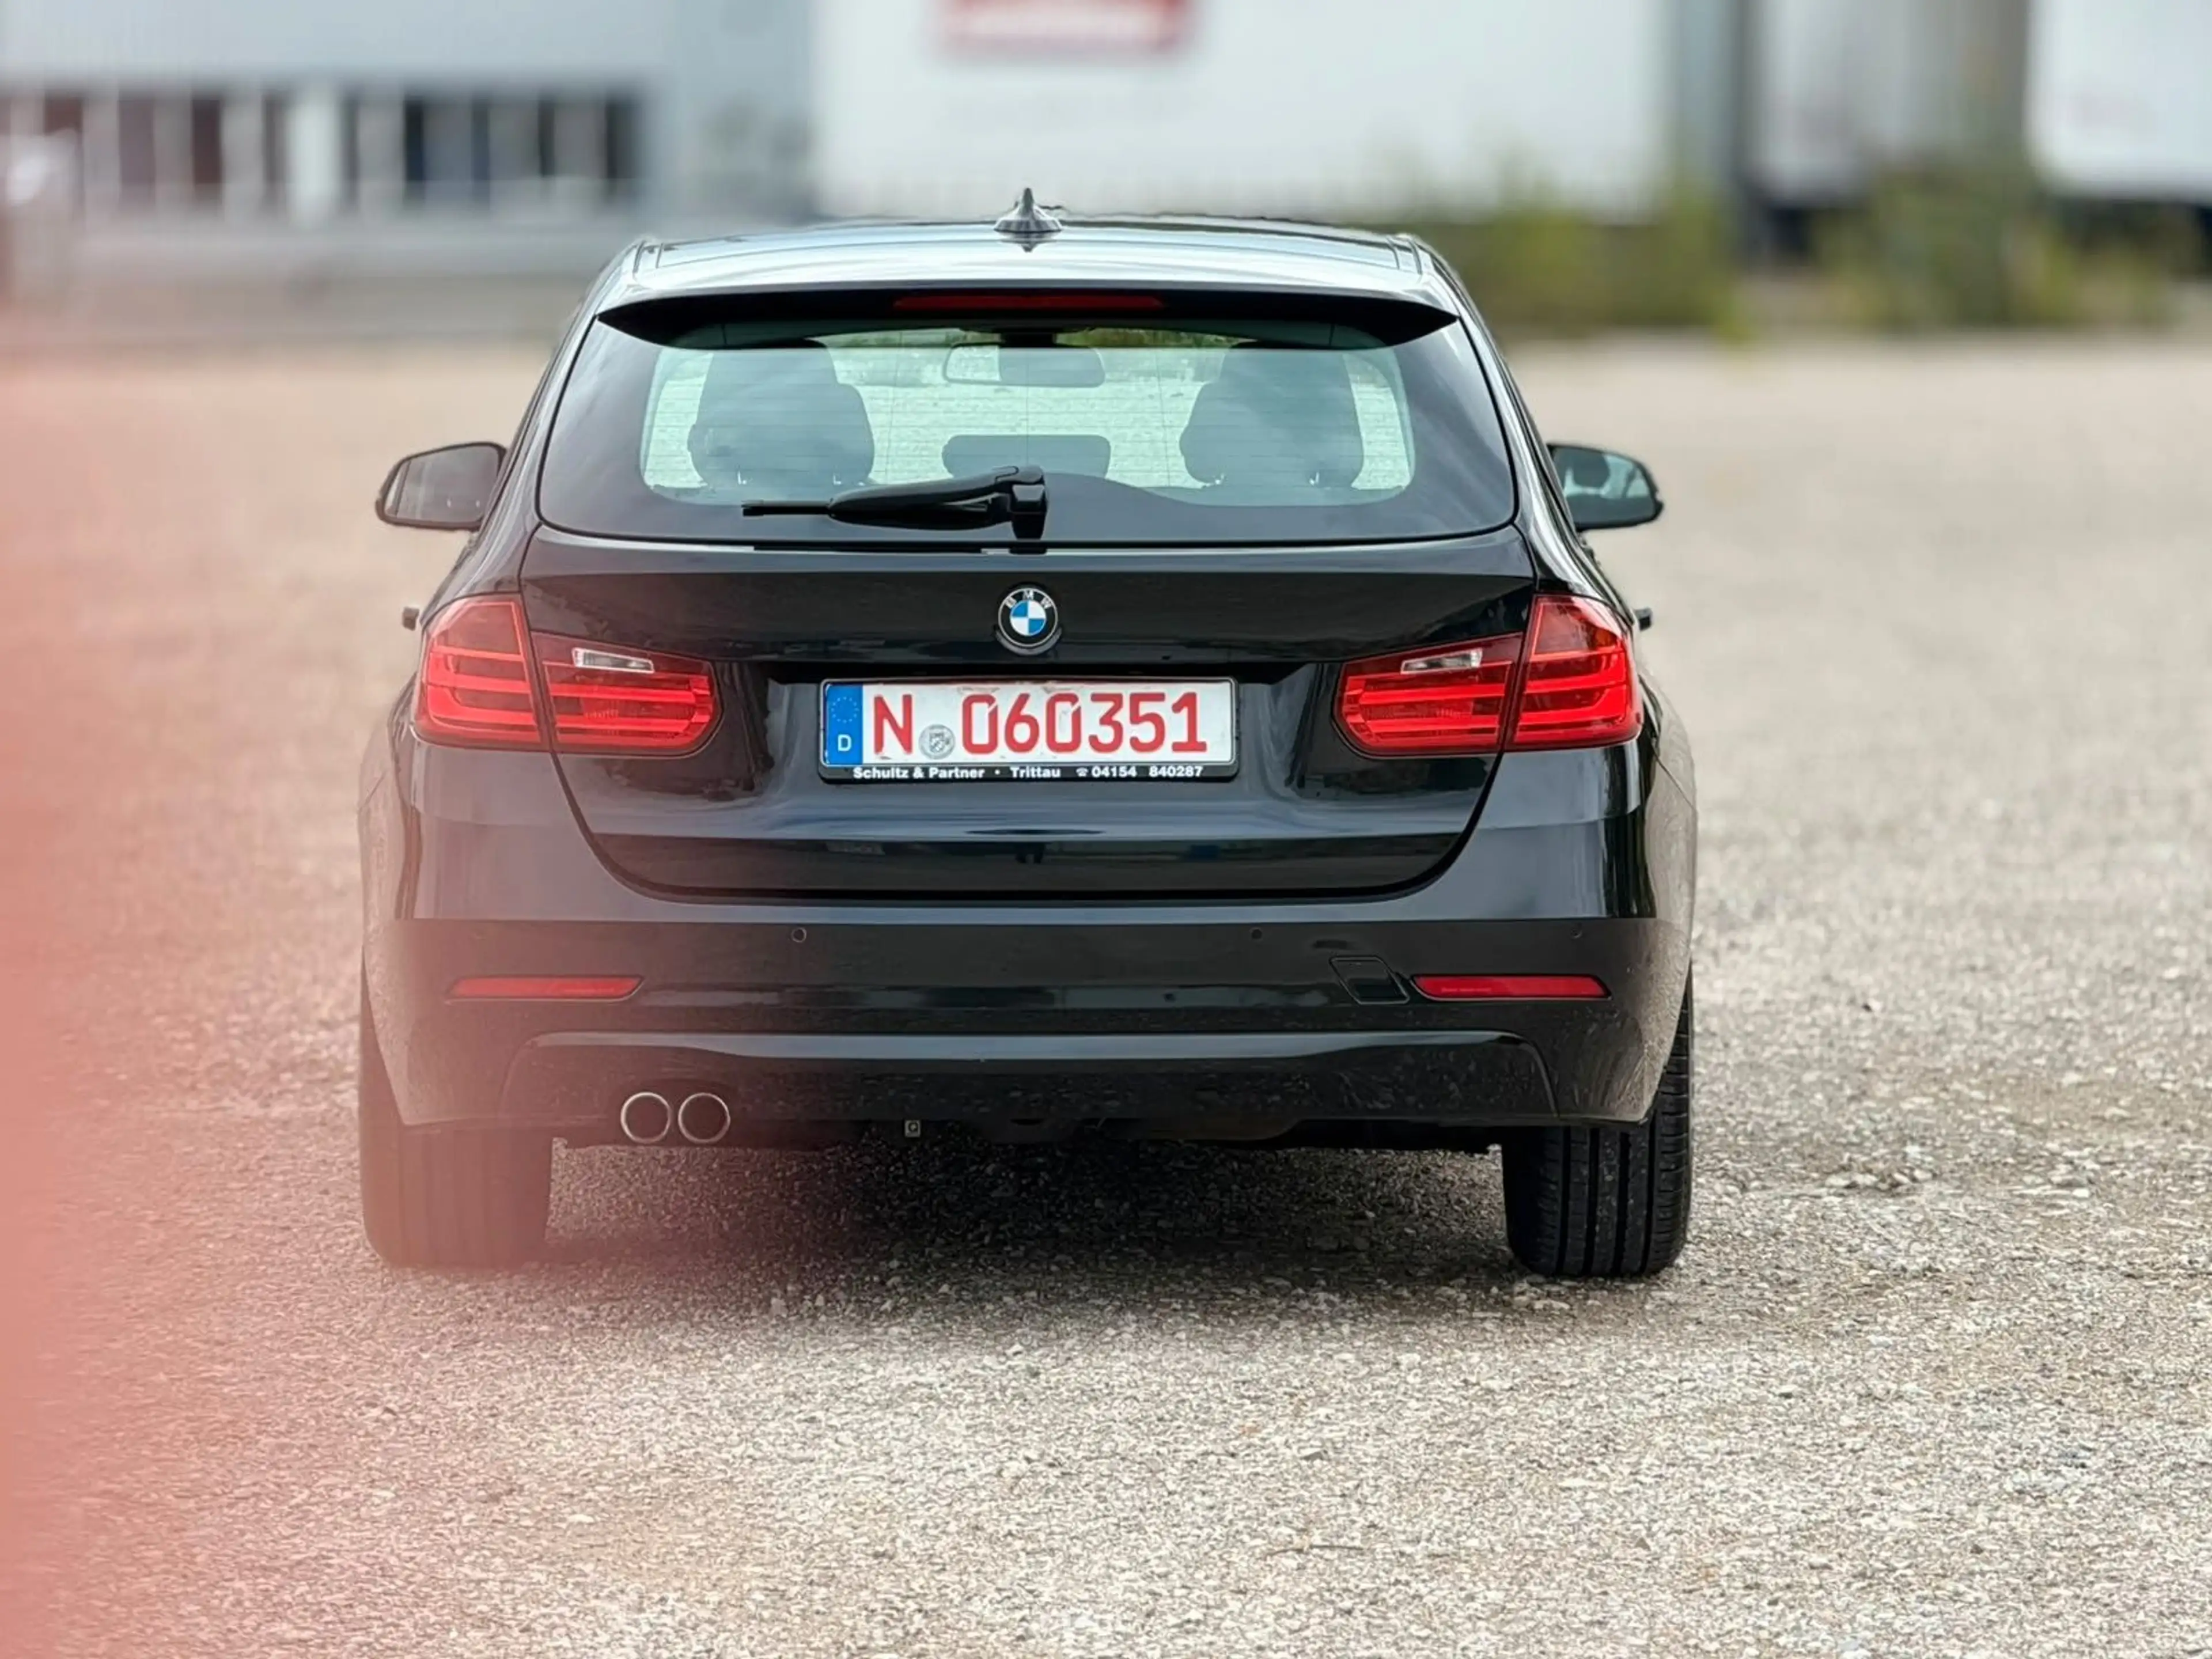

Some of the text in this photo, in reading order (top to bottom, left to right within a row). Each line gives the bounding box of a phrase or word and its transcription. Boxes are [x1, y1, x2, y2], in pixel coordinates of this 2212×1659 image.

[873, 692, 1207, 755] N 060351
[838, 734, 853, 752] D
[853, 766, 1203, 779] Schultz & Partner Trittau 04154 840287
